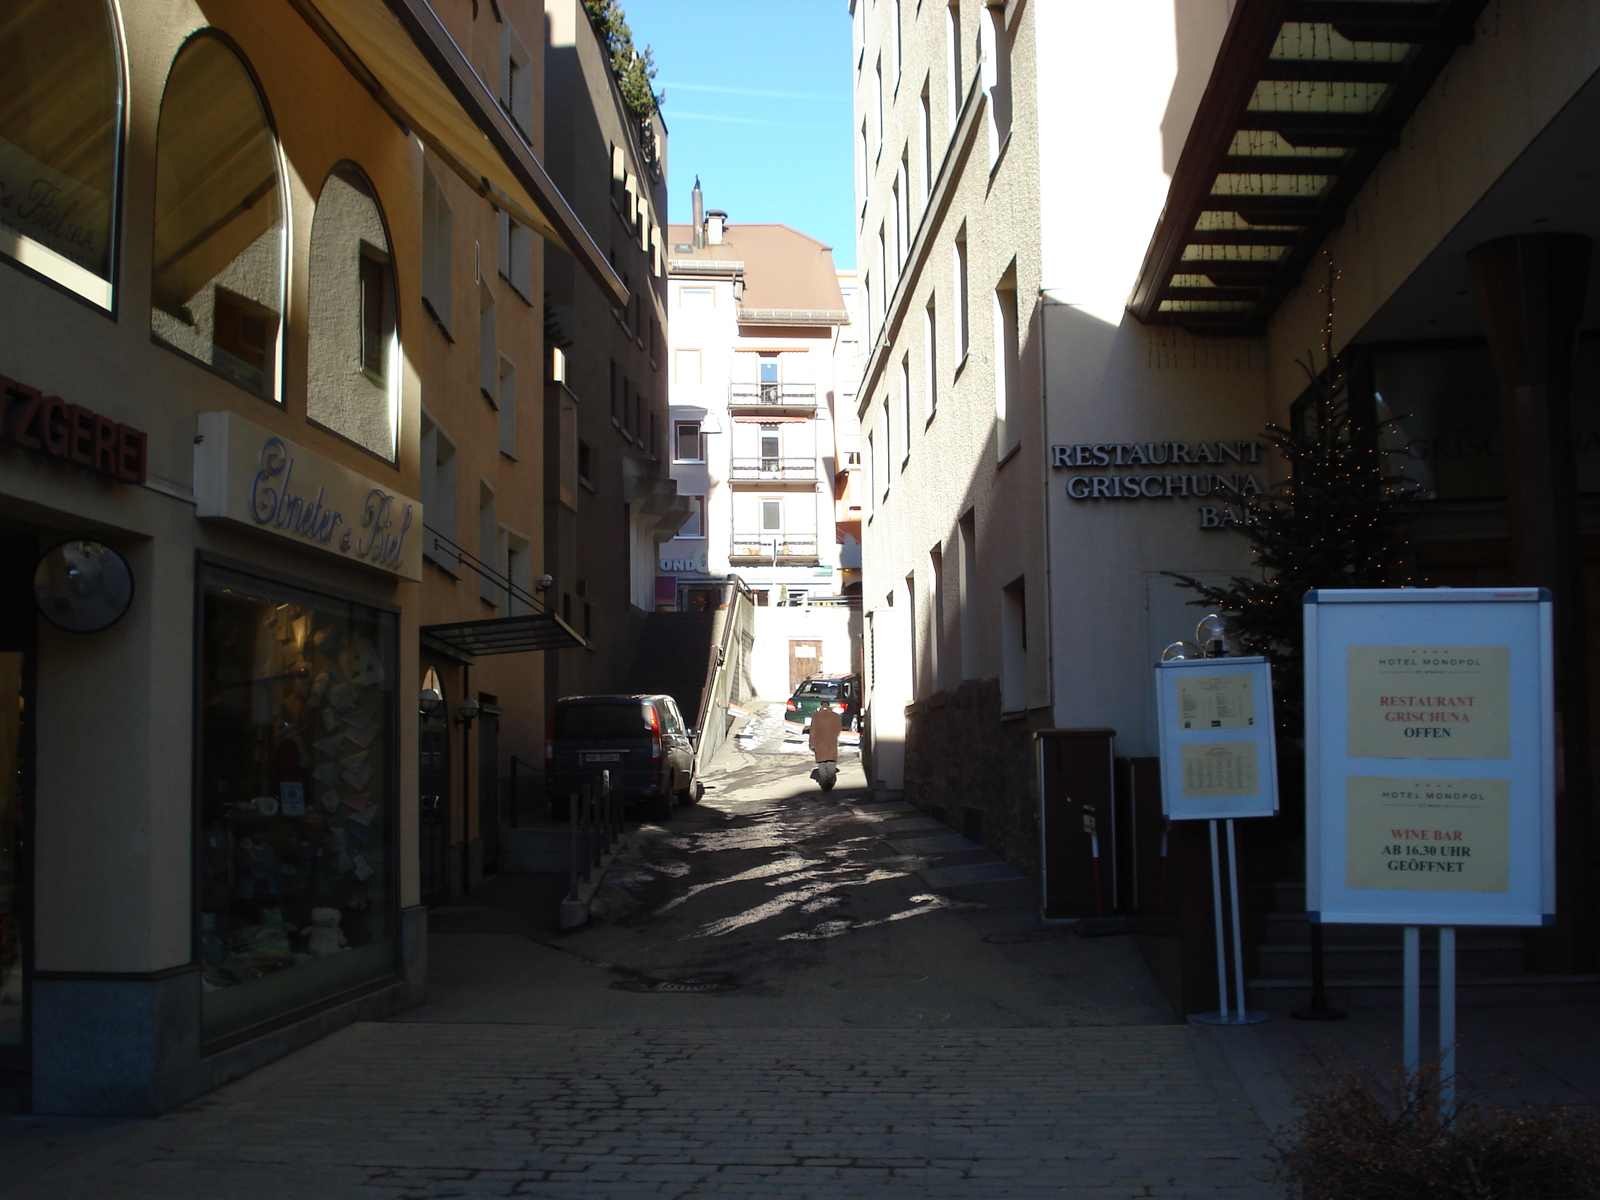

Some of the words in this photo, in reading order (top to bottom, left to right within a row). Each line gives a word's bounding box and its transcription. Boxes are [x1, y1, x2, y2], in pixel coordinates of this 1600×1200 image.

[1052, 441, 1263, 468] RESTAURANT
[1066, 473, 1263, 499] GRISCHUNA
[357, 489, 413, 571] Biel
[1379, 658, 1417, 666] HOTEL
[1423, 658, 1481, 666] MONOPOL
[1379, 696, 1476, 707] RESTAURANT
[1384, 711, 1470, 723] GRISCHUNA
[1404, 727, 1451, 738] OFFEN
[1382, 791, 1420, 799] HOTEL
[1426, 792, 1484, 801] MONOPOL
[1391, 829, 1430, 841] WINE
[1433, 830, 1463, 842] BAR
[1382, 845, 1402, 856] AB
[1405, 845, 1436, 857] 16.30
[1440, 846, 1471, 857] UHR
[1387, 859, 1465, 873] GEÖFFNET
